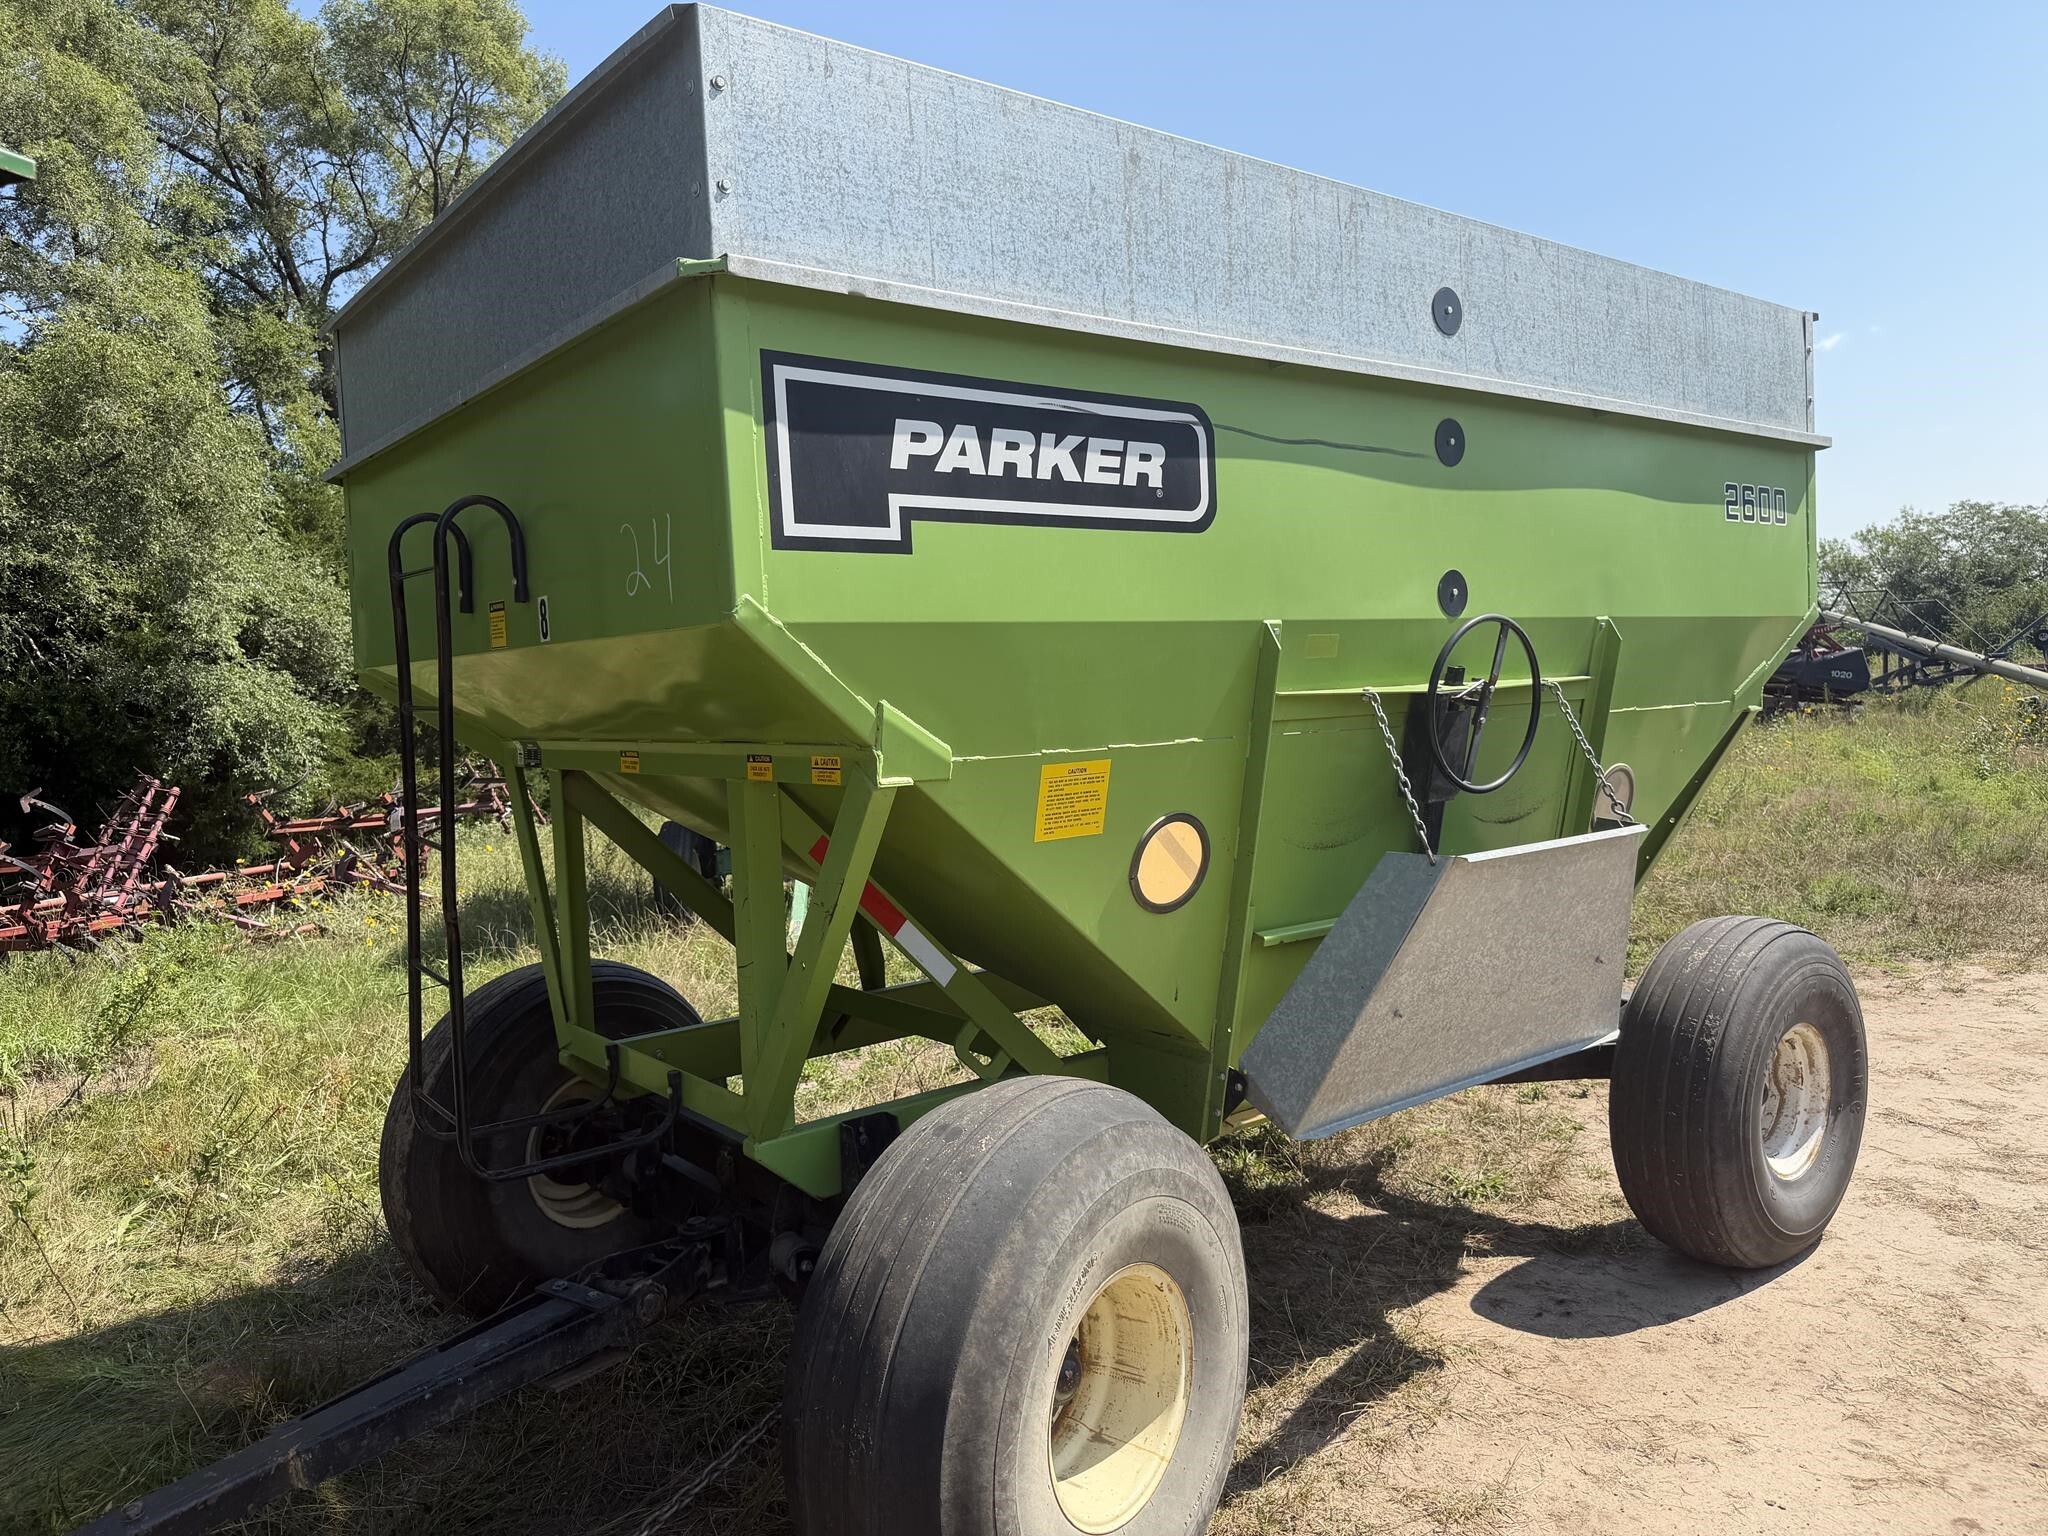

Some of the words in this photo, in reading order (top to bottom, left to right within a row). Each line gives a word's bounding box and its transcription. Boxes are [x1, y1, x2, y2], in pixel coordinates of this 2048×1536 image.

[889, 417, 1166, 488] PARKER
[1724, 482, 1787, 526] 2600
[619, 512, 674, 604] 24
[539, 598, 549, 641] 8
[1831, 670, 1853, 680] 1020
[820, 757, 839, 767] CAUTION
